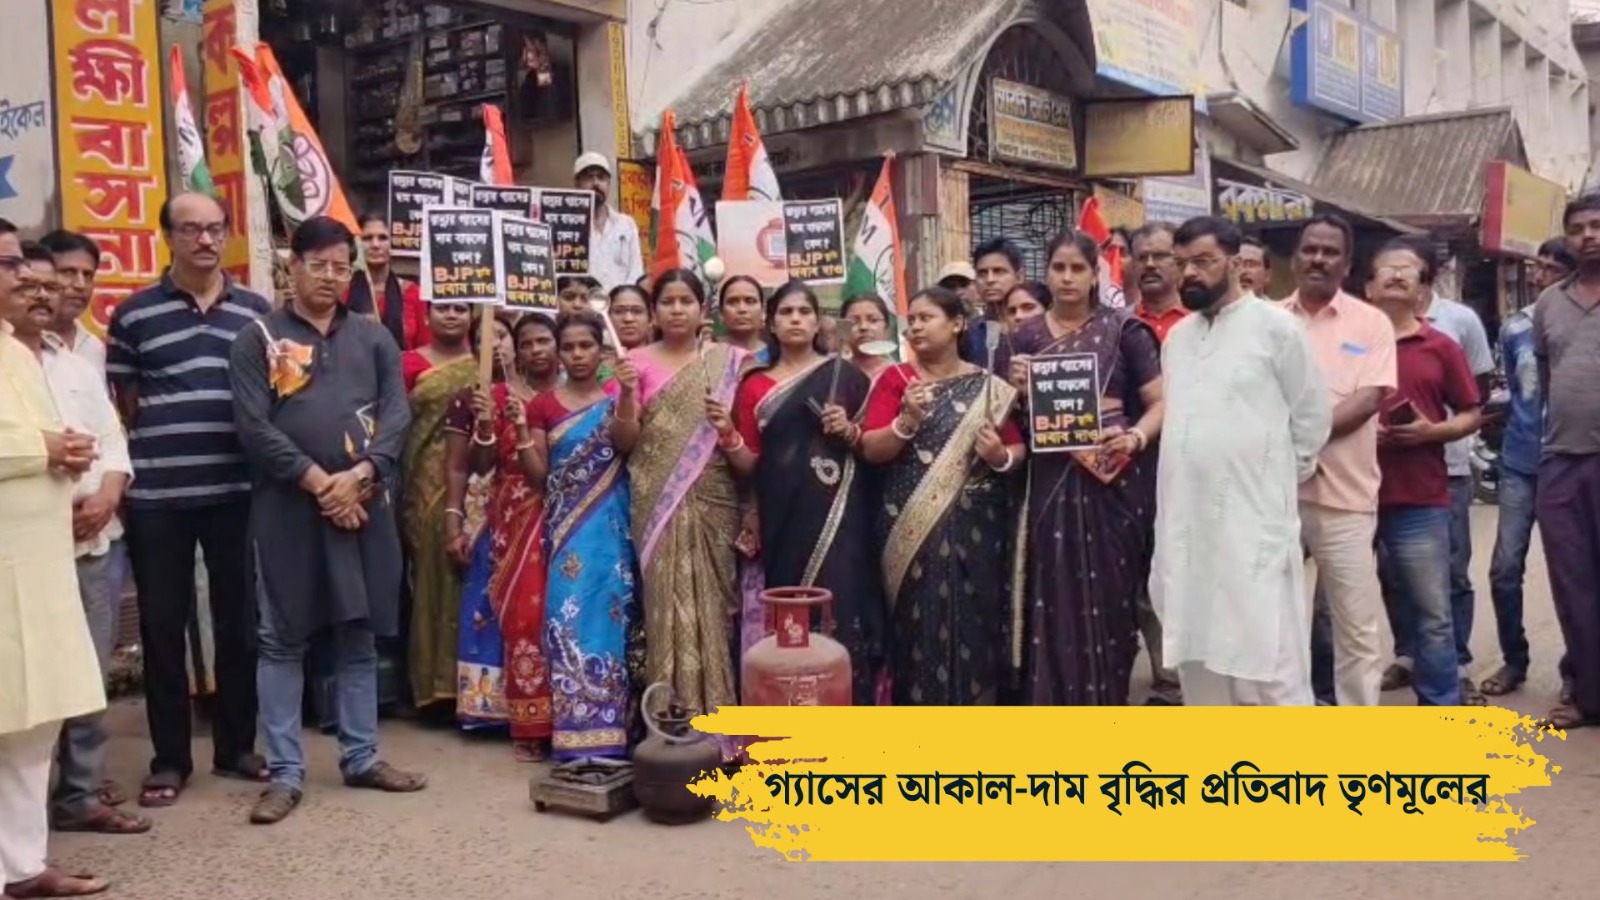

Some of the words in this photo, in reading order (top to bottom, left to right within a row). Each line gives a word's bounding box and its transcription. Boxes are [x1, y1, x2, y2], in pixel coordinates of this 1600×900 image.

[789, 251, 823, 267] BJP
[434, 266, 473, 282] BJP
[507, 274, 539, 290] BJP
[1035, 413, 1076, 430] BJP
